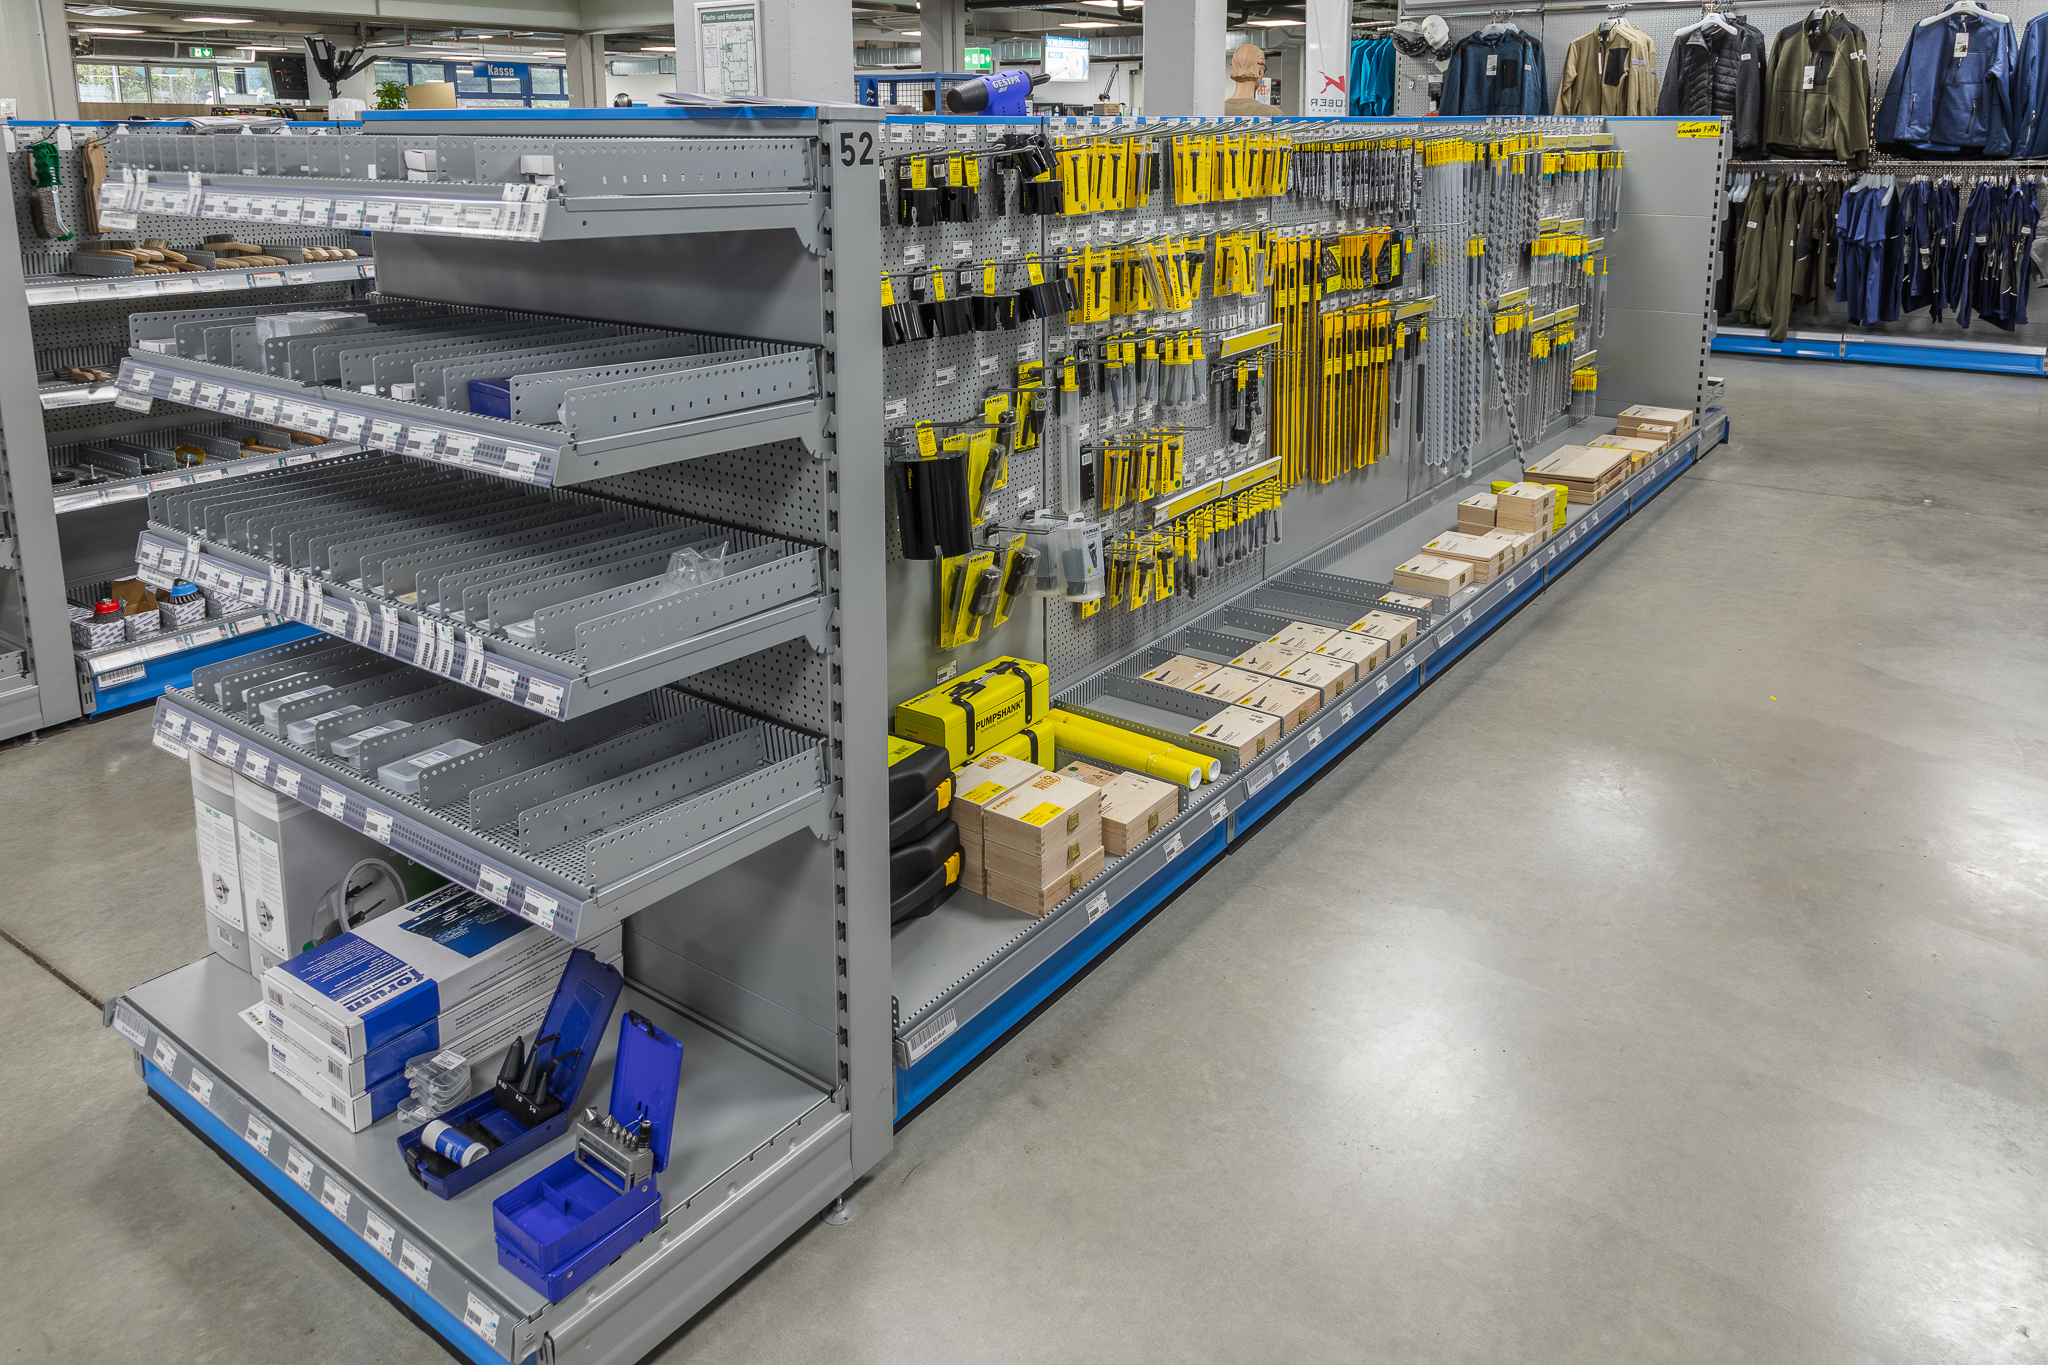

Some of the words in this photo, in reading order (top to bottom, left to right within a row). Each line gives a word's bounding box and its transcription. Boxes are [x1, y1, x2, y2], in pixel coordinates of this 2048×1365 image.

[726, 12, 754, 20] Rettungsplan
[1046, 38, 1090, 50] SCHLÜSSELDIENST
[487, 64, 515, 77] Kasse
[992, 75, 1021, 89] GESIPA
[840, 131, 874, 167] 52
[1173, 279, 1181, 309] Bormax
[975, 701, 1022, 731] PUMPSHANK
[346, 967, 425, 1013] forum
